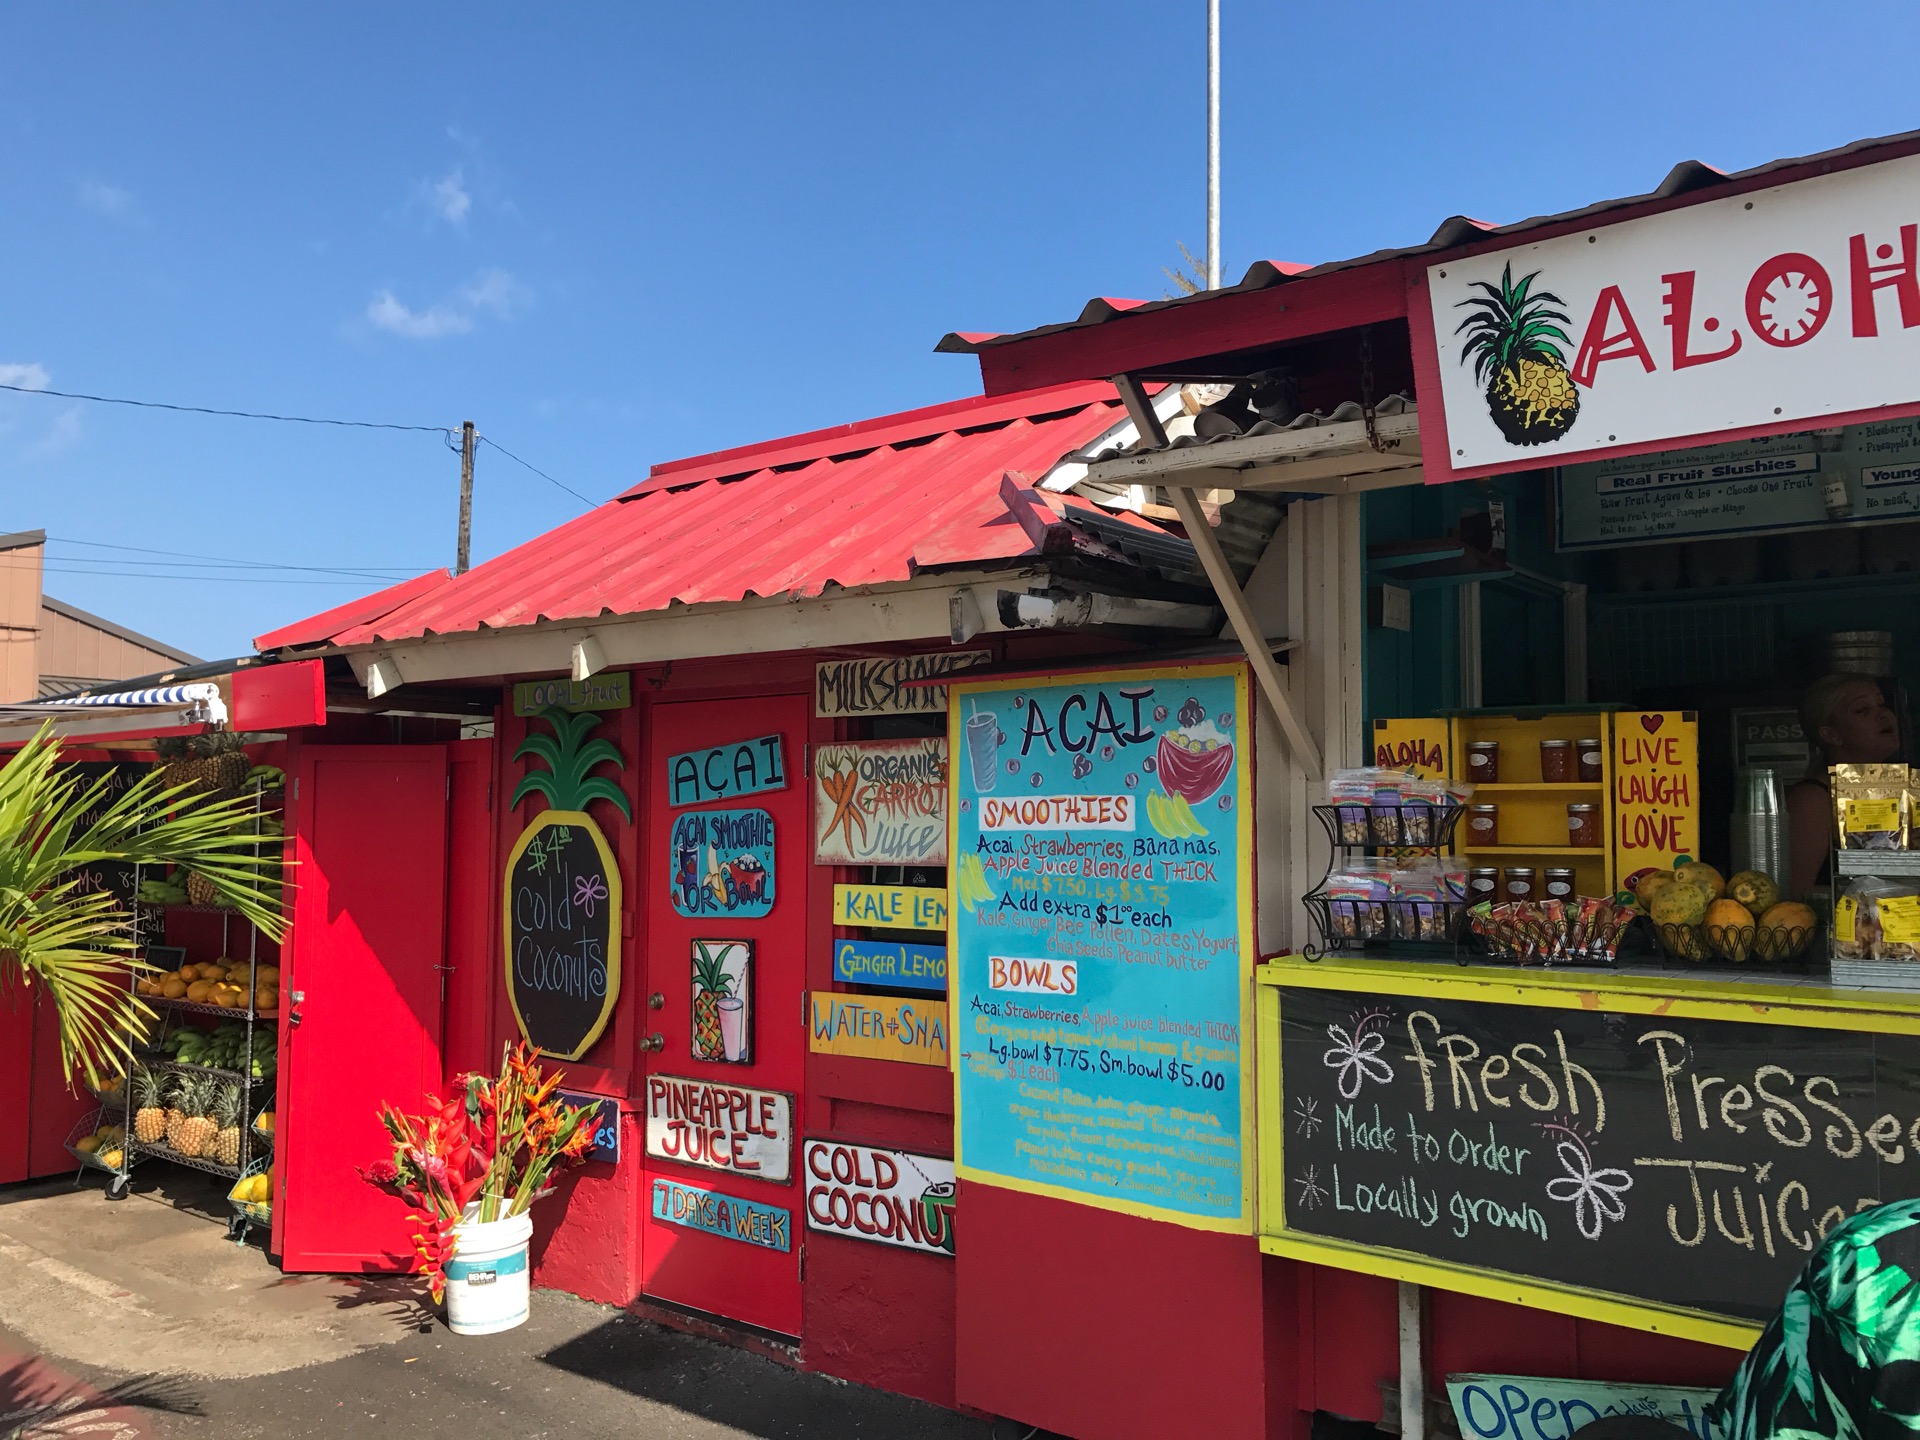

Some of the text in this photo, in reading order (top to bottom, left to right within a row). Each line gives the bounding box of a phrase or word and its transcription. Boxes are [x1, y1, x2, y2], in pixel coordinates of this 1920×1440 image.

[1866, 424, 1912, 438] Blueberry
[1866, 438, 1908, 453] Pineapple
[1613, 475, 1651, 488] Real
[1658, 470, 1704, 483] Fruit
[1712, 459, 1796, 476] Slushies
[1625, 493, 1650, 507] Fruit
[1655, 493, 1681, 508] Agave
[1726, 484, 1758, 496] Choose
[1762, 481, 1779, 493] One
[1783, 474, 1813, 491] Fruit
[1866, 498, 1879, 508] No
[1020, 686, 1156, 756] ACAI
[860, 752, 942, 781] ORGANIC
[1376, 738, 1443, 773] ALOHA
[1621, 737, 1683, 766] LIVE
[856, 781, 948, 825] CARROT
[1618, 774, 1690, 807] LAUGH
[983, 795, 1129, 828] SMOOTHIES
[711, 812, 774, 851] SMOOTHIE
[1621, 813, 1691, 854] LOVE
[983, 855, 1219, 883] Apple Juice Blended THICK
[686, 875, 772, 913] OR BOWL
[846, 891, 903, 922] KALE
[998, 890, 1038, 912] Add
[1042, 897, 1091, 919] extra
[1131, 906, 1172, 928] each
[1056, 915, 1085, 935] Bee
[839, 944, 896, 979] GINGER
[990, 956, 1077, 994] BOWLS
[1118, 944, 1163, 965] Peanut
[1165, 948, 1211, 971] butter
[813, 1000, 885, 1041] WATER
[898, 1005, 946, 1051] SNA
[1081, 1006, 1119, 1036] Apple
[1121, 1013, 1153, 1031] juice
[1158, 1016, 1201, 1039] blended
[1204, 1019, 1239, 1044] THICK
[1028, 1063, 1060, 1083] each
[1167, 1057, 1225, 1092] $5.00
[650, 1079, 778, 1139] PINEAPPLE
[662, 1119, 762, 1170] JUICE
[1335, 1103, 1397, 1153] Made
[1407, 1112, 1440, 1164] to
[808, 1143, 899, 1190] COLD
[658, 1183, 786, 1247] 7 DAYS A WEEK
[1333, 1164, 1549, 1242] Locally grown
